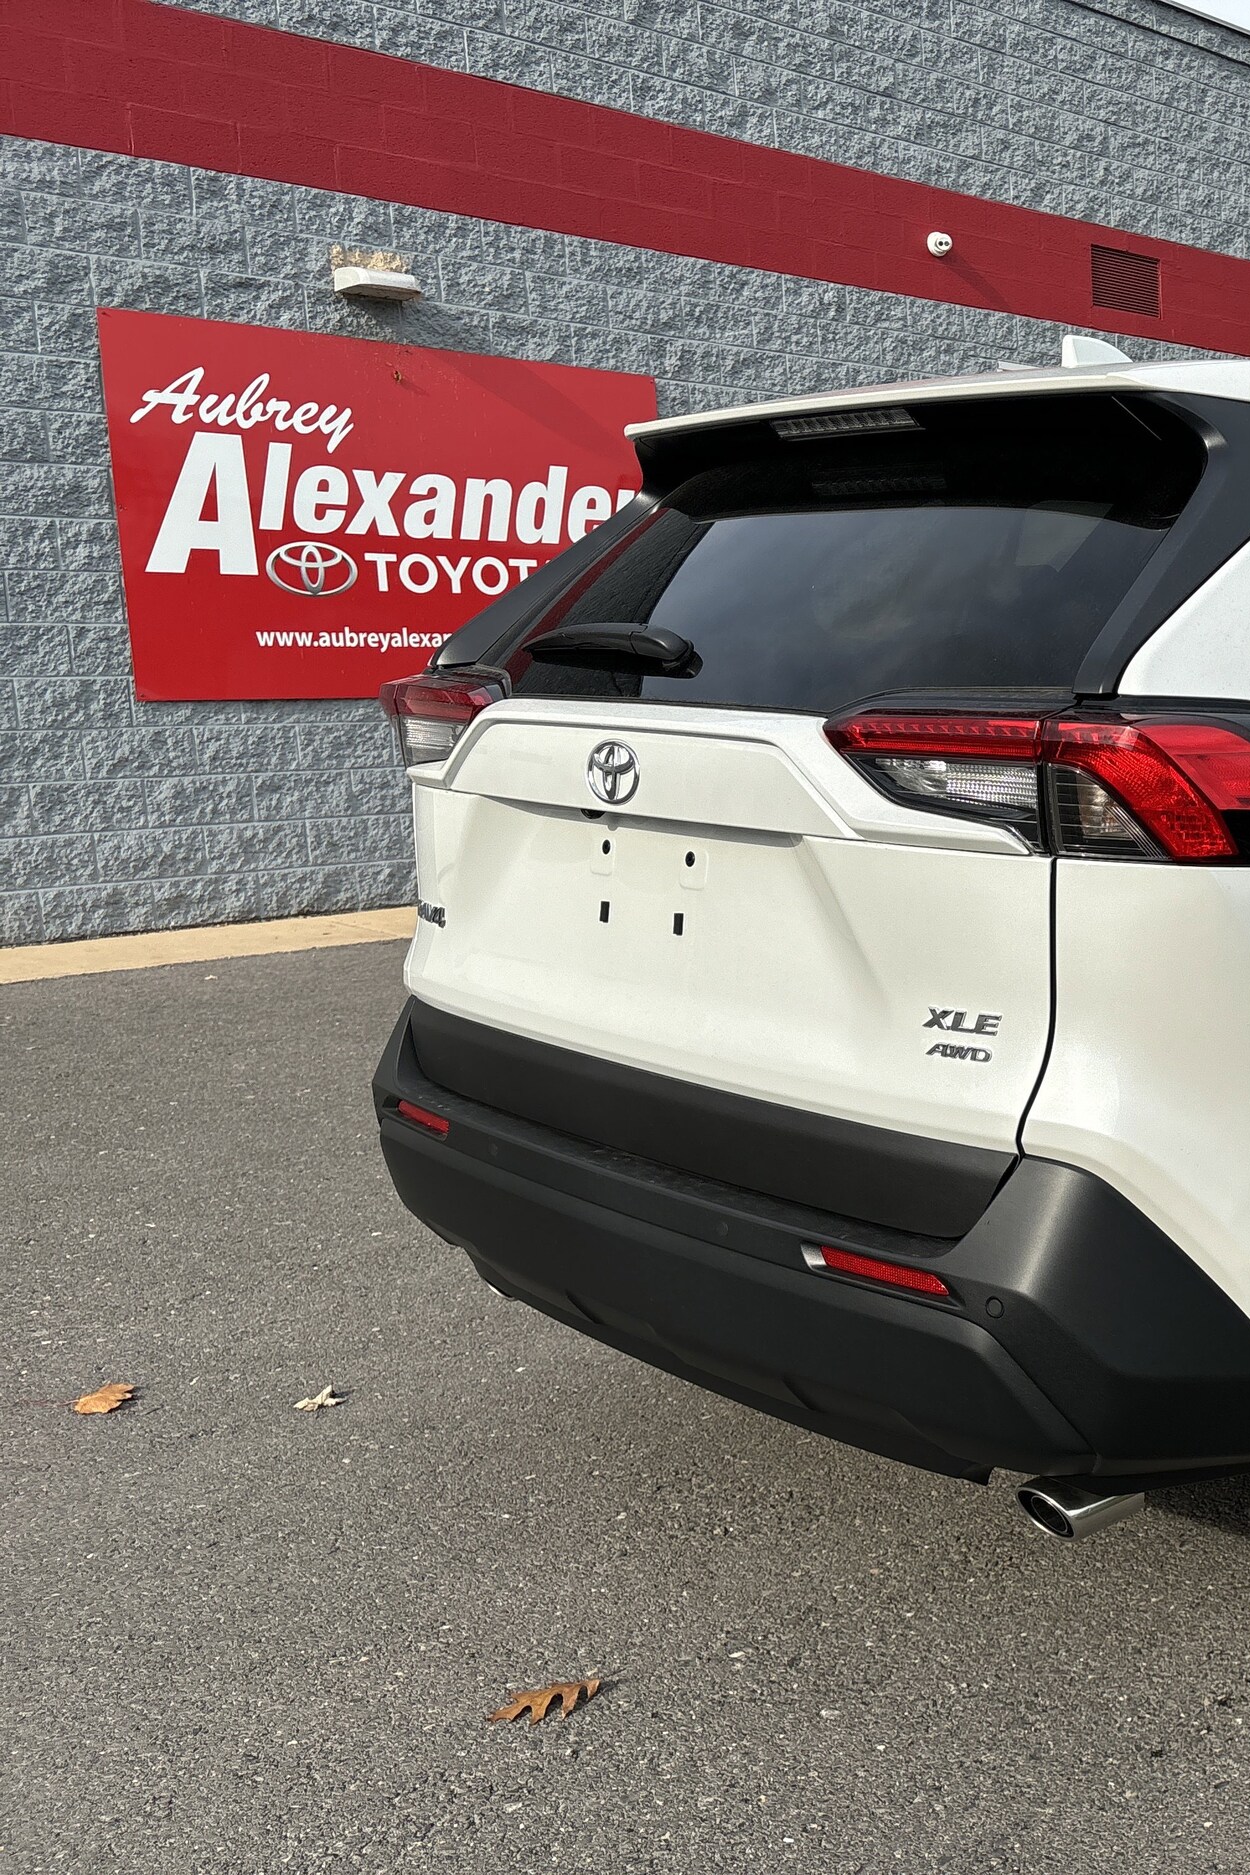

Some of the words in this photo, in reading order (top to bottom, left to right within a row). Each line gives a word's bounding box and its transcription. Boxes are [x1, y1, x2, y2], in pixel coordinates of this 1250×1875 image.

[130, 366, 354, 454] Aubrey
[364, 552, 550, 596] TOYOT
[922, 1005, 1002, 1036] XLE
[926, 1042, 992, 1063] AWD
